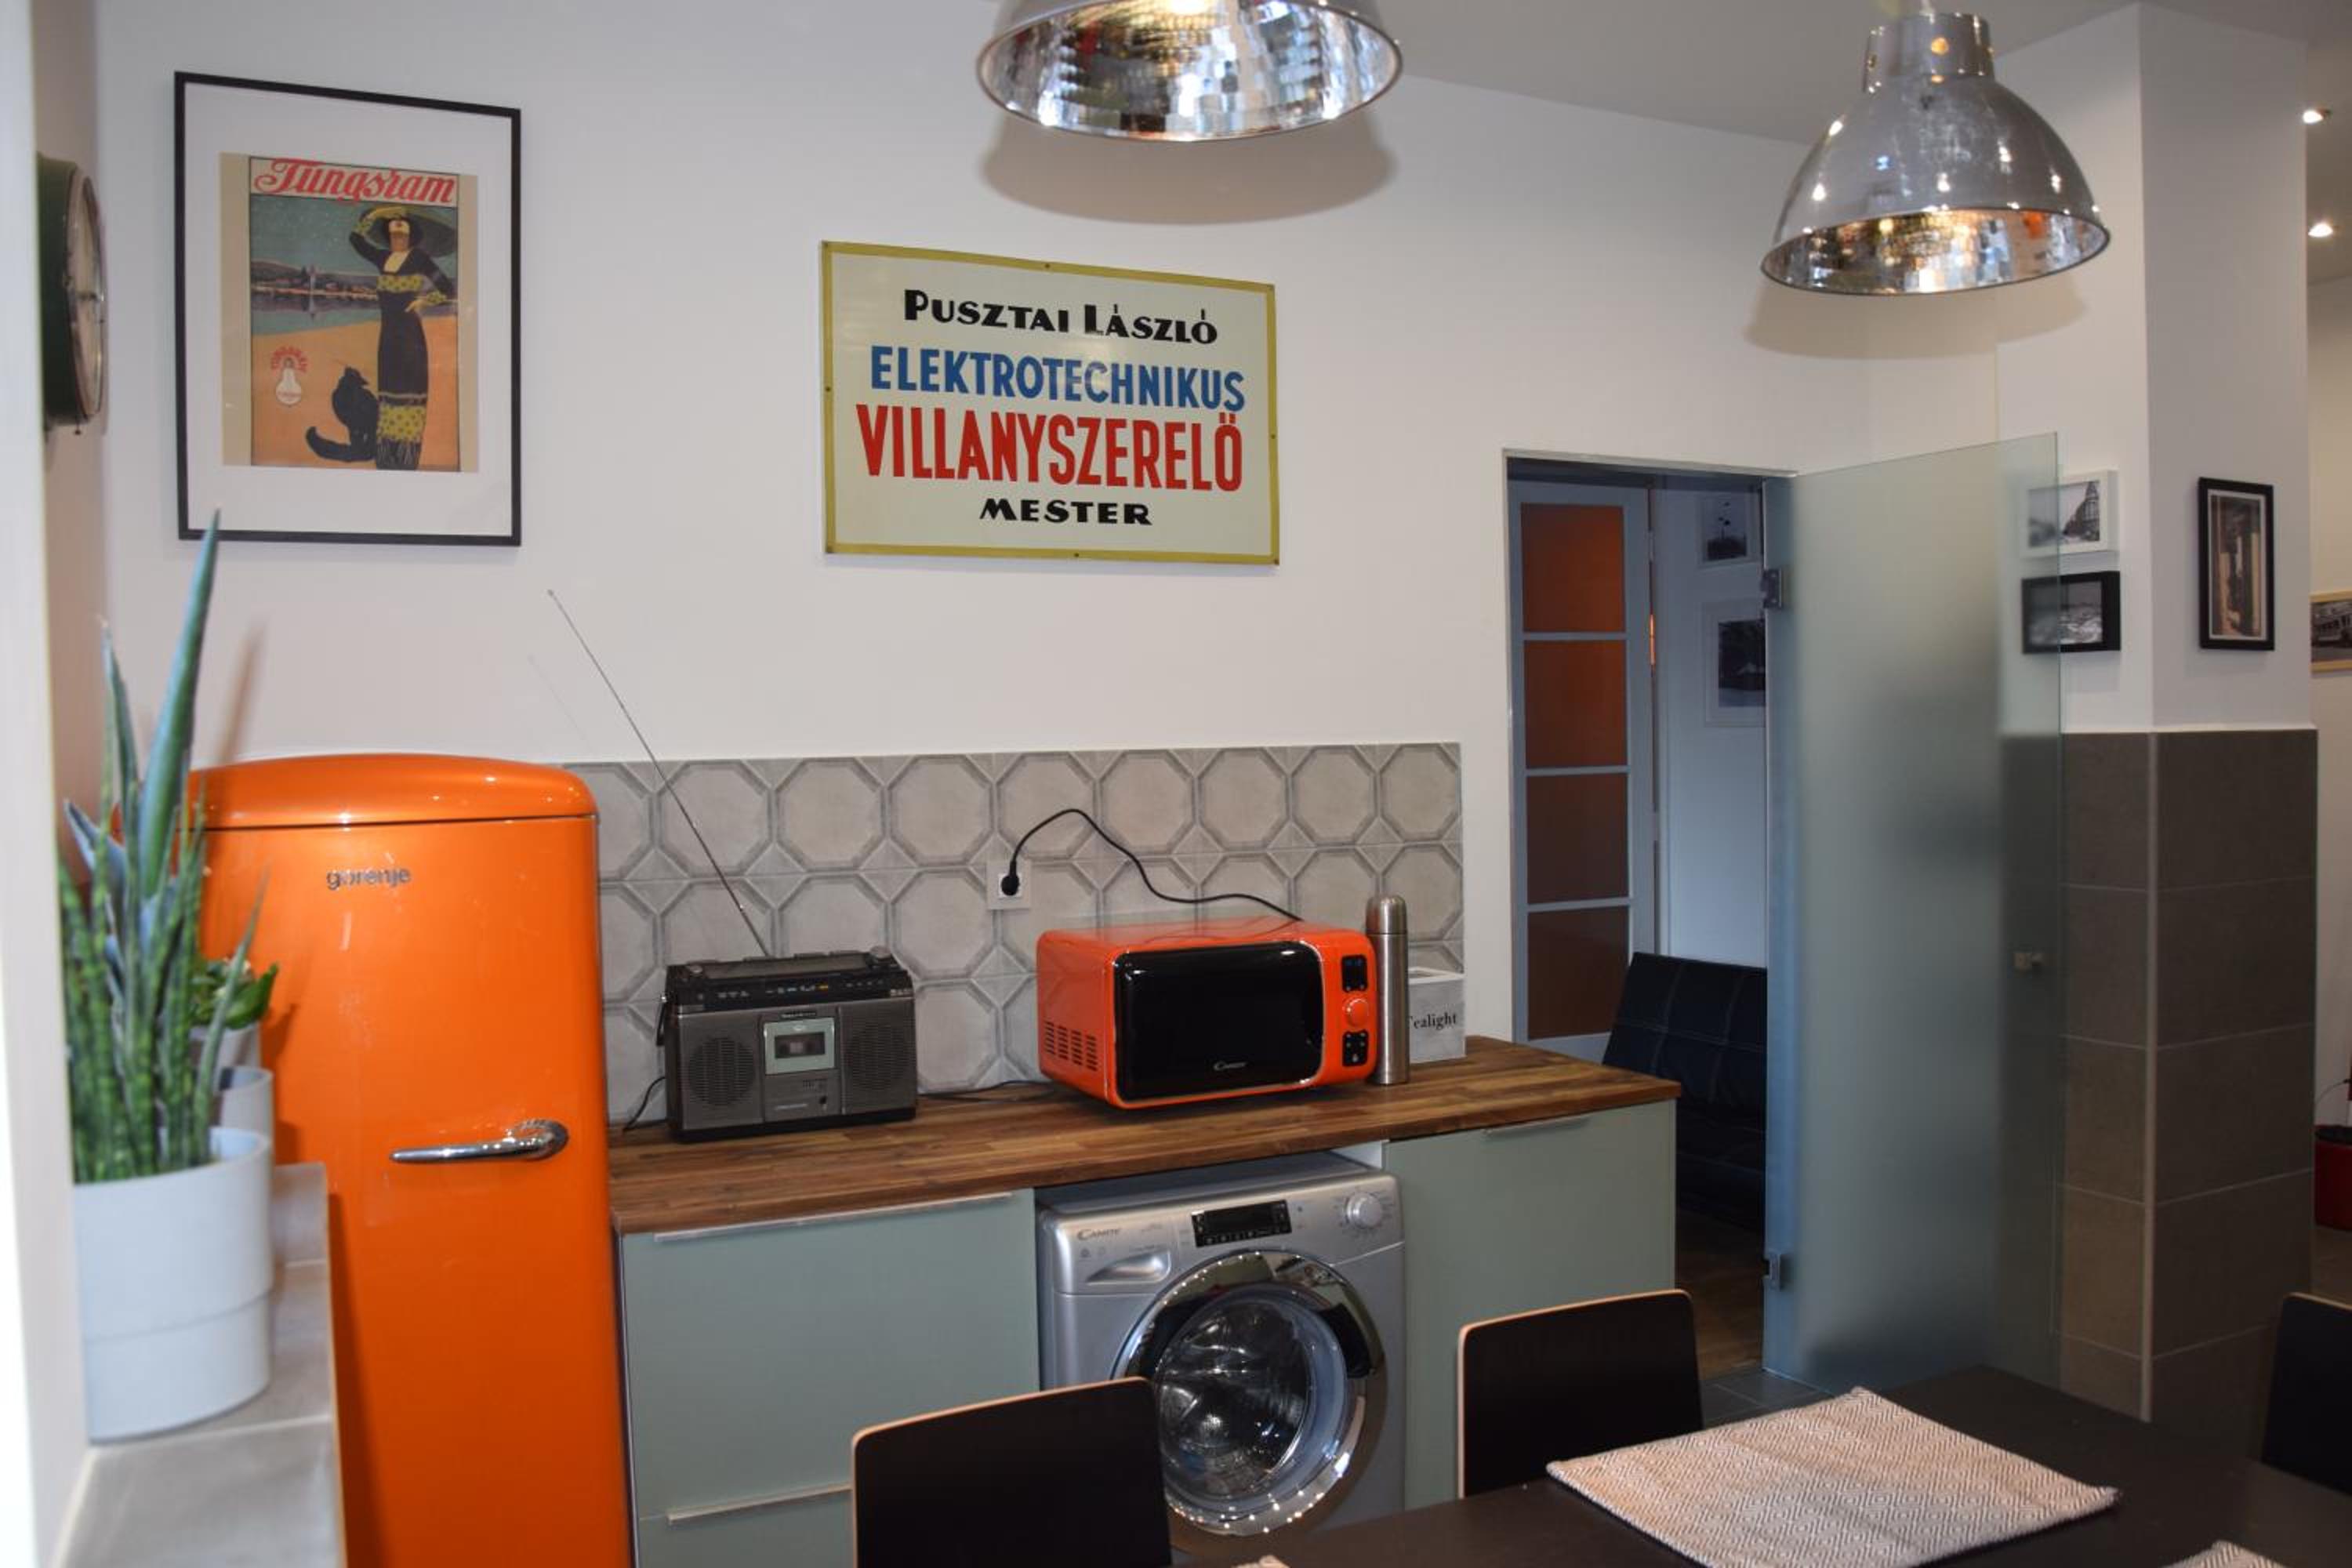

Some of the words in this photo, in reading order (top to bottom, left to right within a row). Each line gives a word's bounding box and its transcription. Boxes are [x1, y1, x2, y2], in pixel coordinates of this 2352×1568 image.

[254, 158, 455, 204] Tungsram
[871, 345, 1245, 412] ELEKTROTECHNIKUS
[979, 498, 1152, 525] MESTER
[326, 868, 412, 891] gorenje
